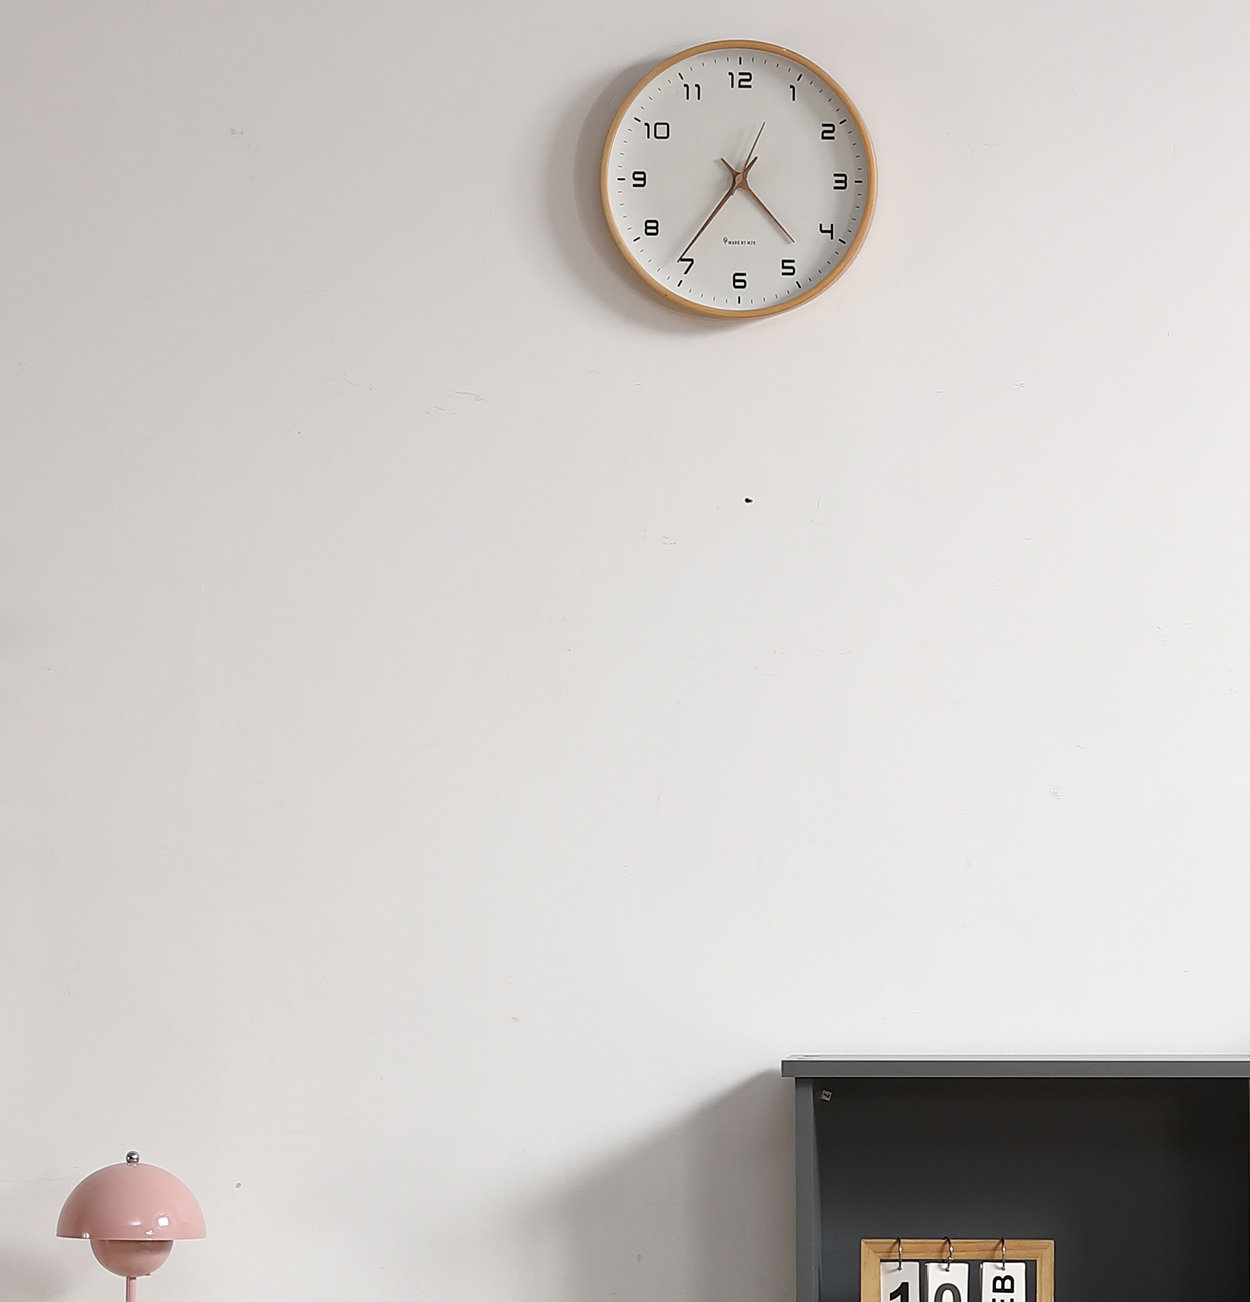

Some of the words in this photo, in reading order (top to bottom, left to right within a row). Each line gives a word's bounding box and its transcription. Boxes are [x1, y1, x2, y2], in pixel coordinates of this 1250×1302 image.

[728, 72, 752, 88] 12
[683, 84, 700, 100] 11
[790, 85, 795, 101] 1
[644, 122, 670, 139] 10
[821, 124, 835, 139] 2
[632, 171, 646, 187] 9
[833, 173, 847, 190] 3
[644, 220, 659, 236] 8
[820, 224, 834, 240] 4
[680, 258, 694, 274] 7
[781, 260, 795, 275] 5
[732, 273, 746, 289] 6
